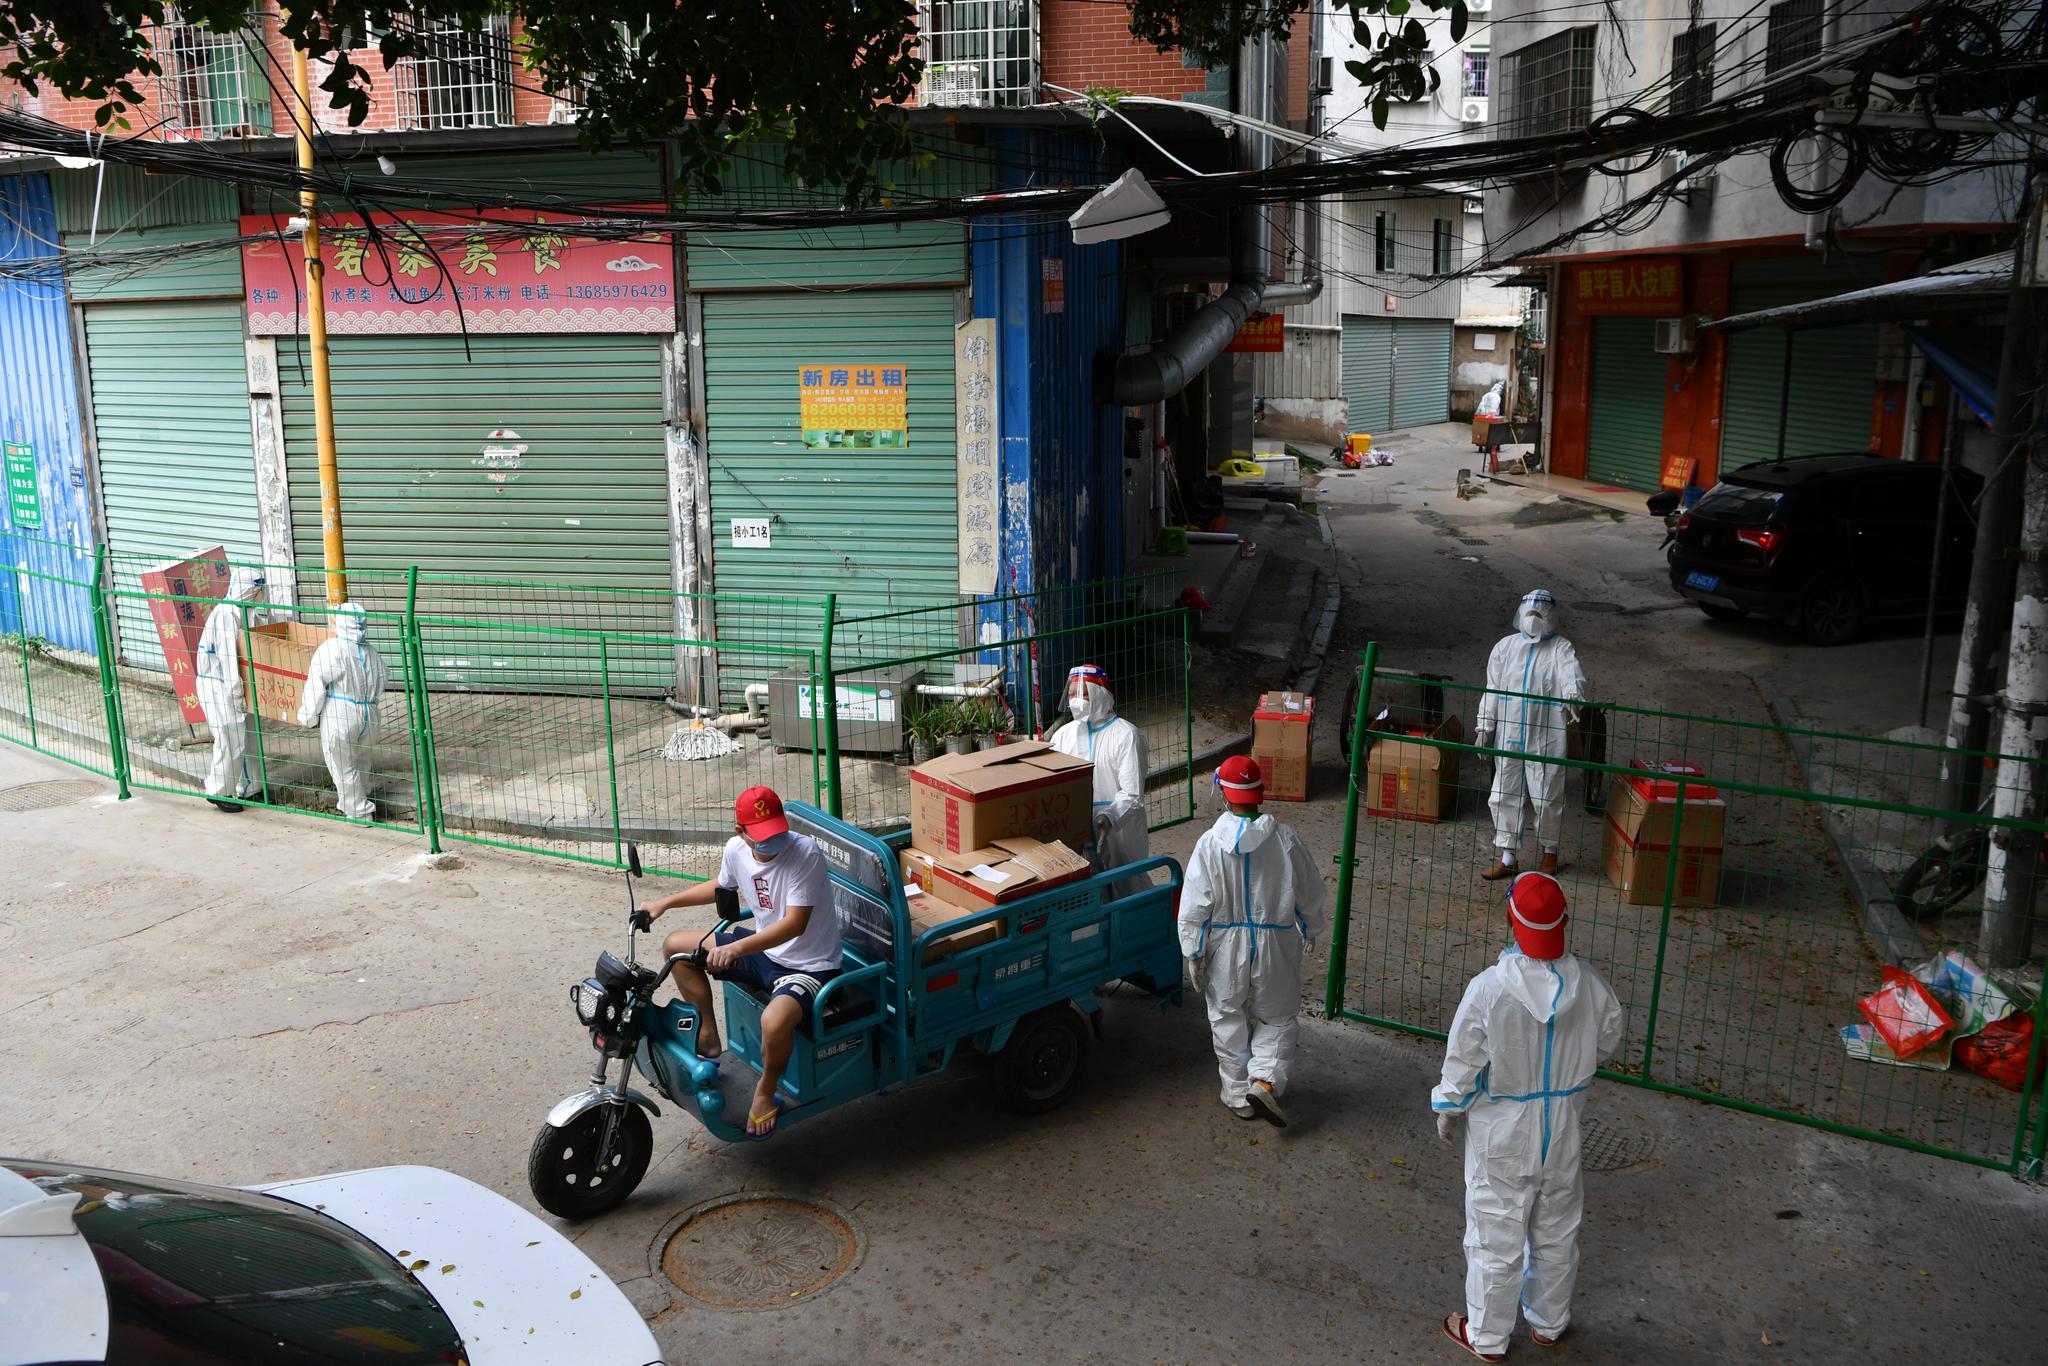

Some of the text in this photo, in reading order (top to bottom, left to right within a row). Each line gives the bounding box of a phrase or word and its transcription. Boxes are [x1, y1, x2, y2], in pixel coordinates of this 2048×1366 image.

[333, 217, 569, 278] 客家美食
[566, 284, 668, 299] 13685976429
[802, 368, 903, 388] 新房出租
[802, 403, 905, 416] 18206093320
[802, 417, 906, 430] 15392028557
[734, 525, 768, 538] 招小工1名
[1009, 792, 1070, 826] CAKE
